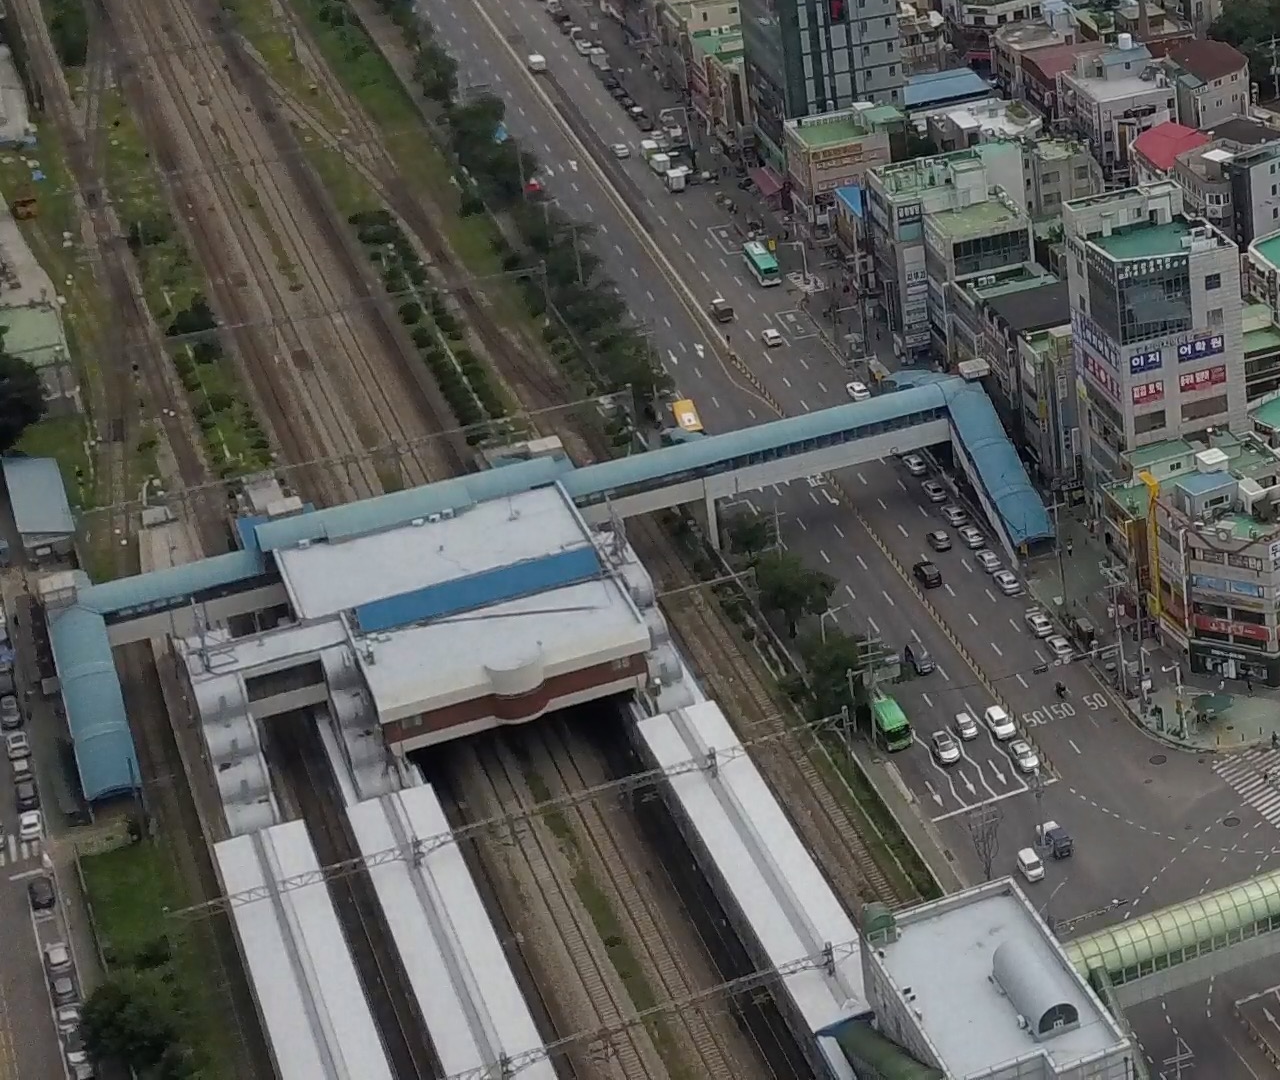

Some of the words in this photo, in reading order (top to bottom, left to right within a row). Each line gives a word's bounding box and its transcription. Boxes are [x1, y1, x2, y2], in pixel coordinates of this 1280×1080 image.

[1179, 336, 1222, 355] 어학원
[1131, 351, 1160, 367] 이지
[1050, 702, 1076, 719] 50
[1082, 692, 1108, 710] 50
